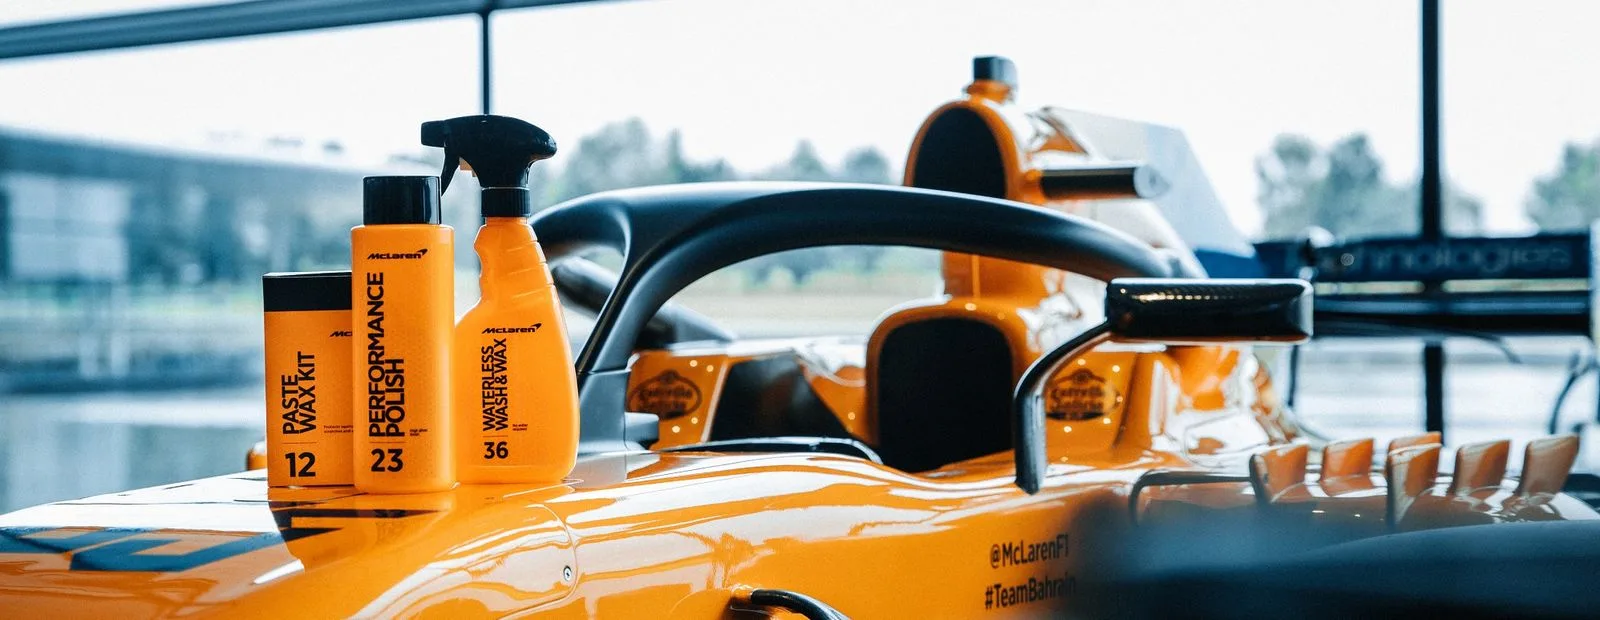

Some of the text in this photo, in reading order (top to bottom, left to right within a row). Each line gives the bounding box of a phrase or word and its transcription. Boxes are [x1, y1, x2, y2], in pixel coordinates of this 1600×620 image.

[367, 250, 426, 260] McLaren
[481, 323, 540, 334] McLaren
[367, 272, 385, 437] PERFORMANCE
[494, 338, 507, 372] WAX
[281, 374, 299, 434] PASTE
[297, 351, 316, 433] WAX KIT
[385, 358, 405, 437] POLISH
[481, 345, 495, 432] WATERLESS
[495, 387, 508, 431] WASH
[285, 452, 316, 478] 12
[371, 448, 404, 473] 23
[484, 441, 509, 460] 36
[990, 534, 1069, 569] @McLarenF1
[985, 572, 1077, 610] #TeamBahrain
